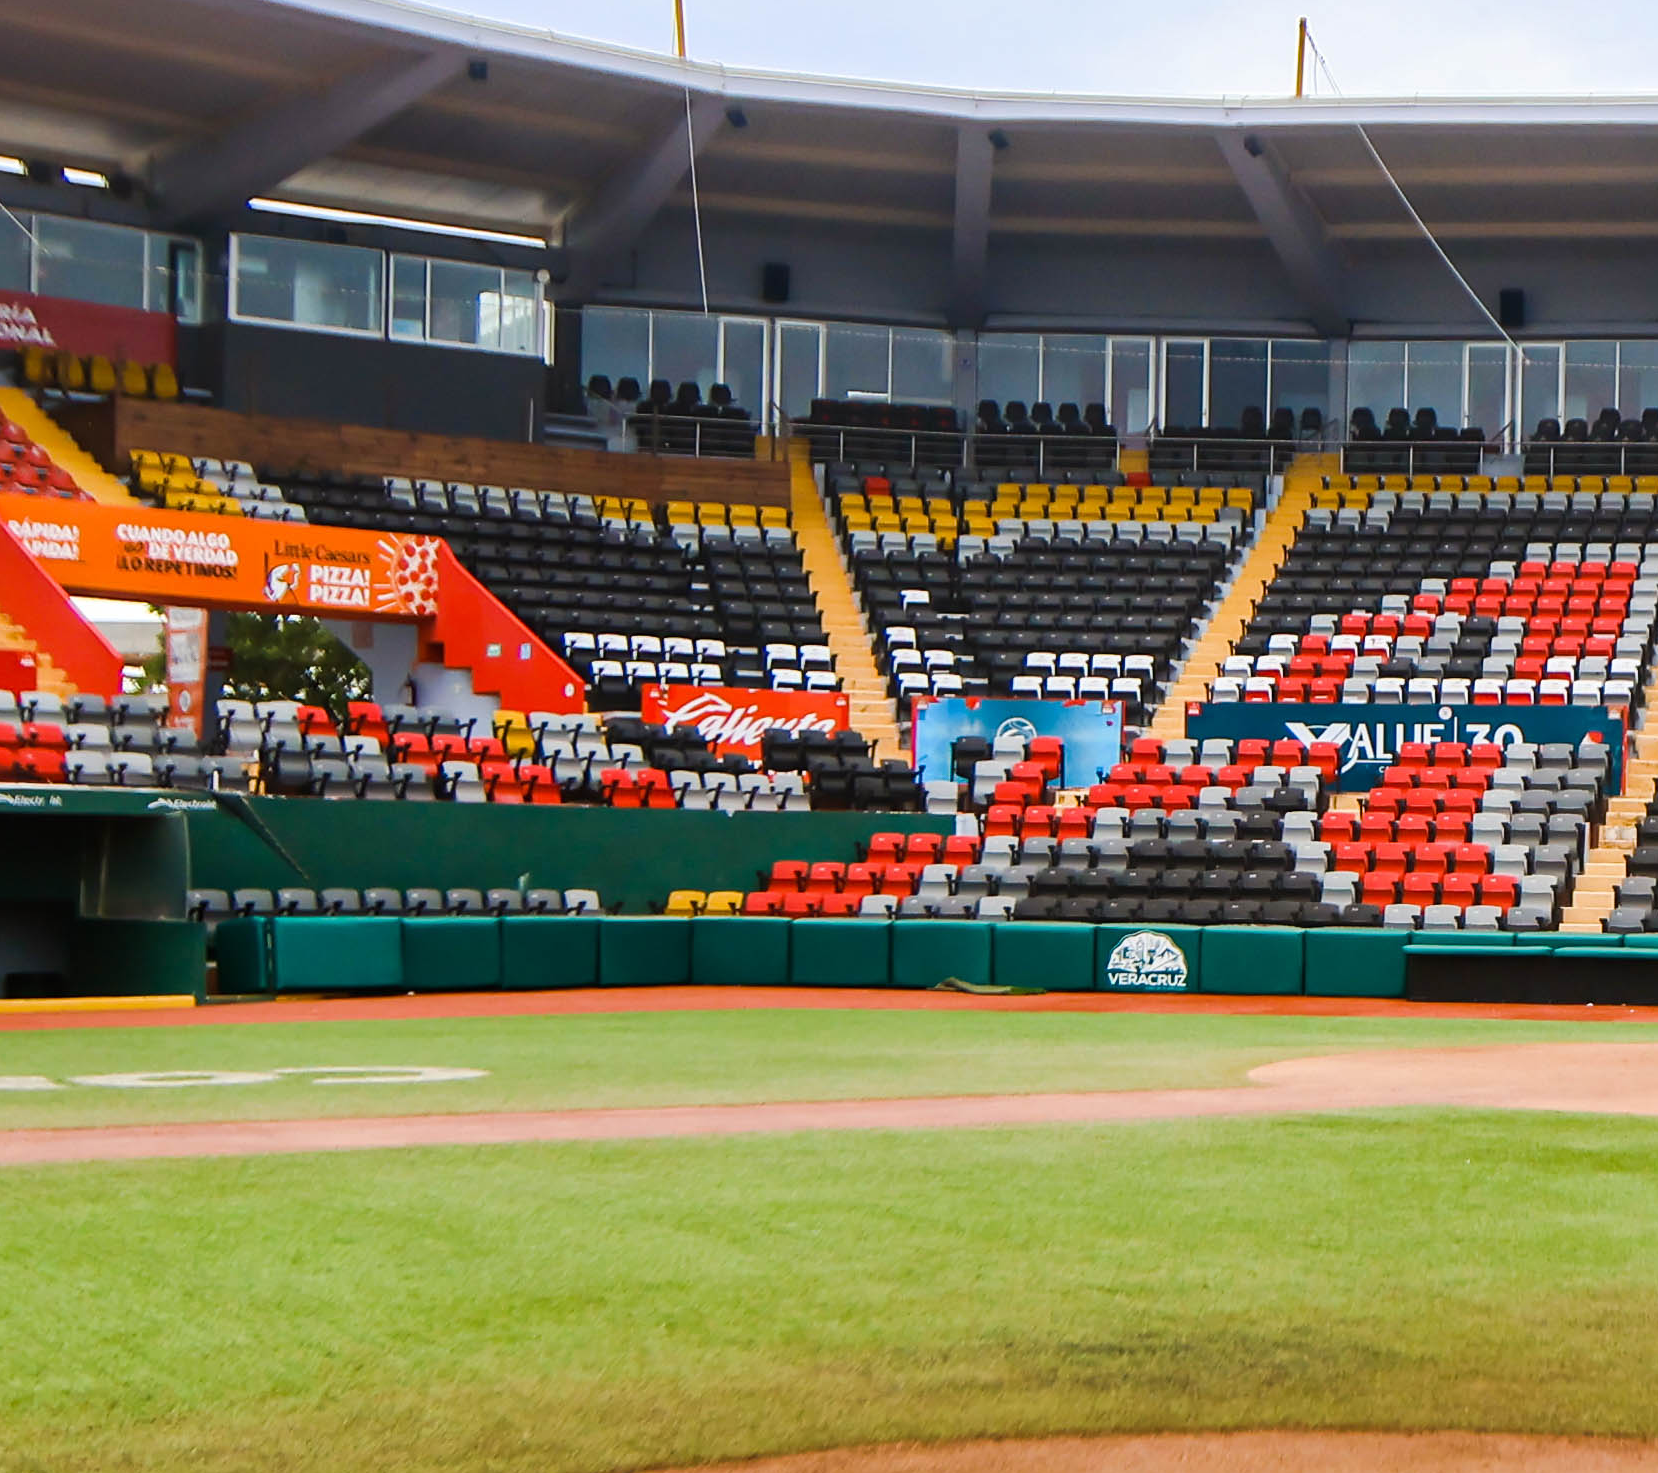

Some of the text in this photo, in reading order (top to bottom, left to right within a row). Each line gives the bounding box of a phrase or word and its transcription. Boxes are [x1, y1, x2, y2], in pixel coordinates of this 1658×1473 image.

[116, 523, 230, 548] CUANDO ALGO
[148, 541, 170, 560] DE
[172, 543, 238, 566] VERDAD
[274, 539, 371, 565] Little Caesars
[308, 564, 371, 588] PIZZA!
[308, 583, 371, 607] PIZZA!
[1108, 972, 1186, 987] VERACRUZ
